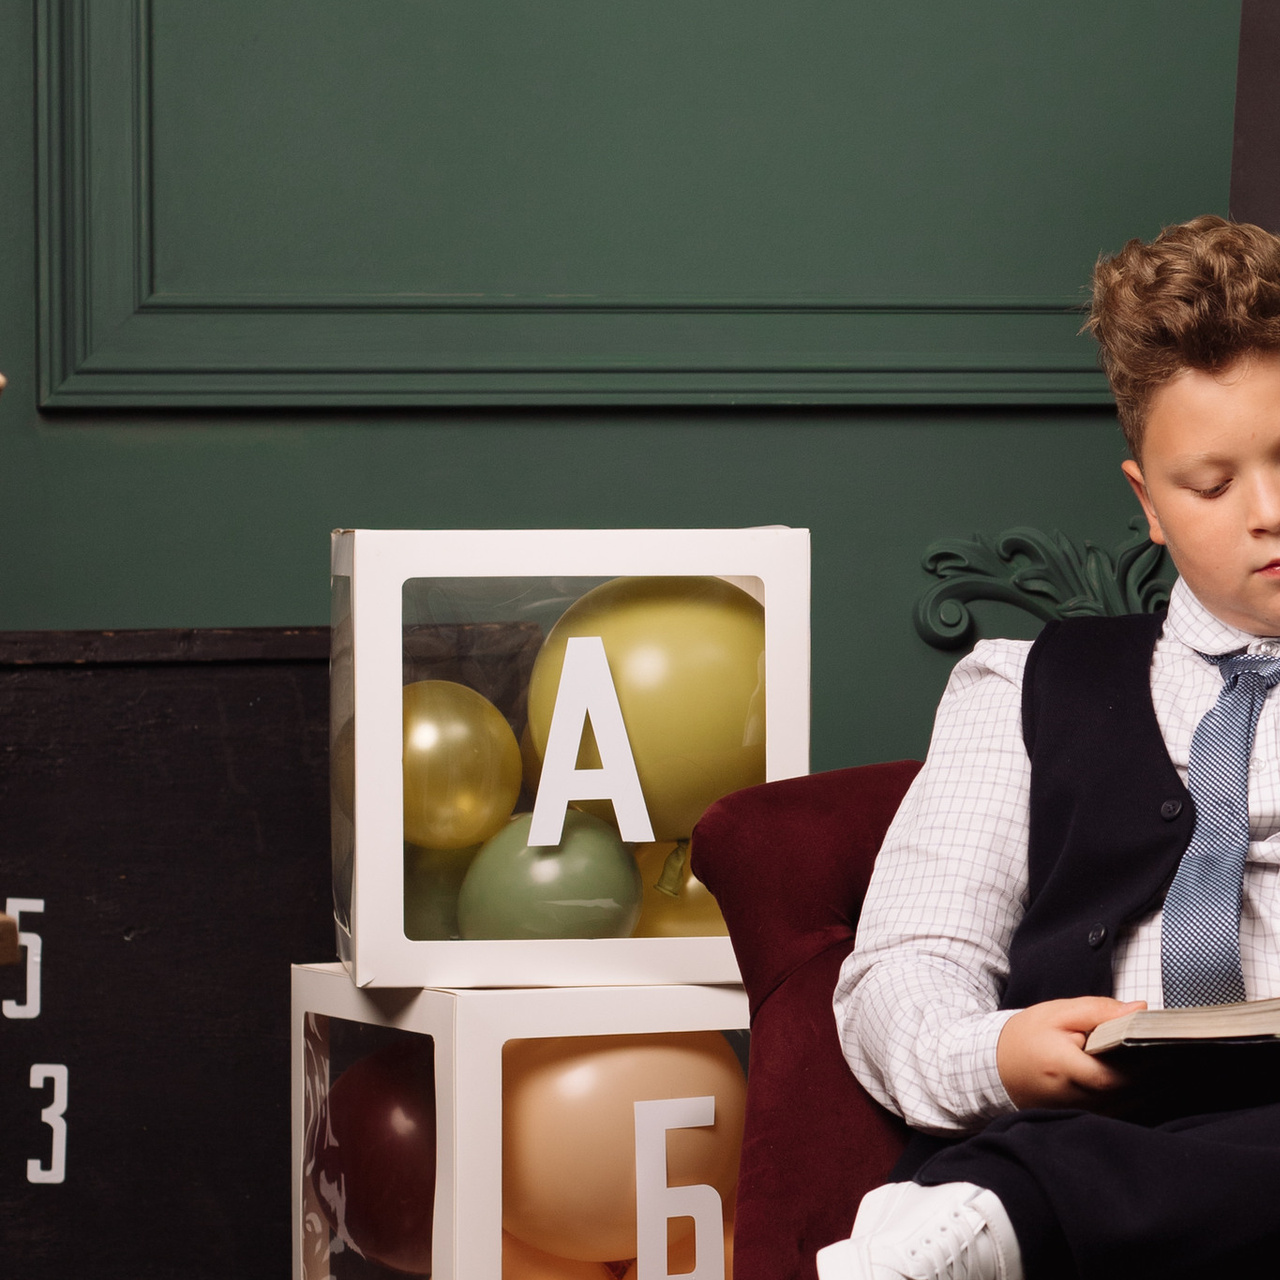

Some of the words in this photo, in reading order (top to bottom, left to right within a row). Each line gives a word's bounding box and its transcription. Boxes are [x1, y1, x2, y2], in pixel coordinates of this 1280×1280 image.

[526, 636, 657, 847] А
[2, 897, 45, 1019] 5
[26, 1063, 69, 1184] 3
